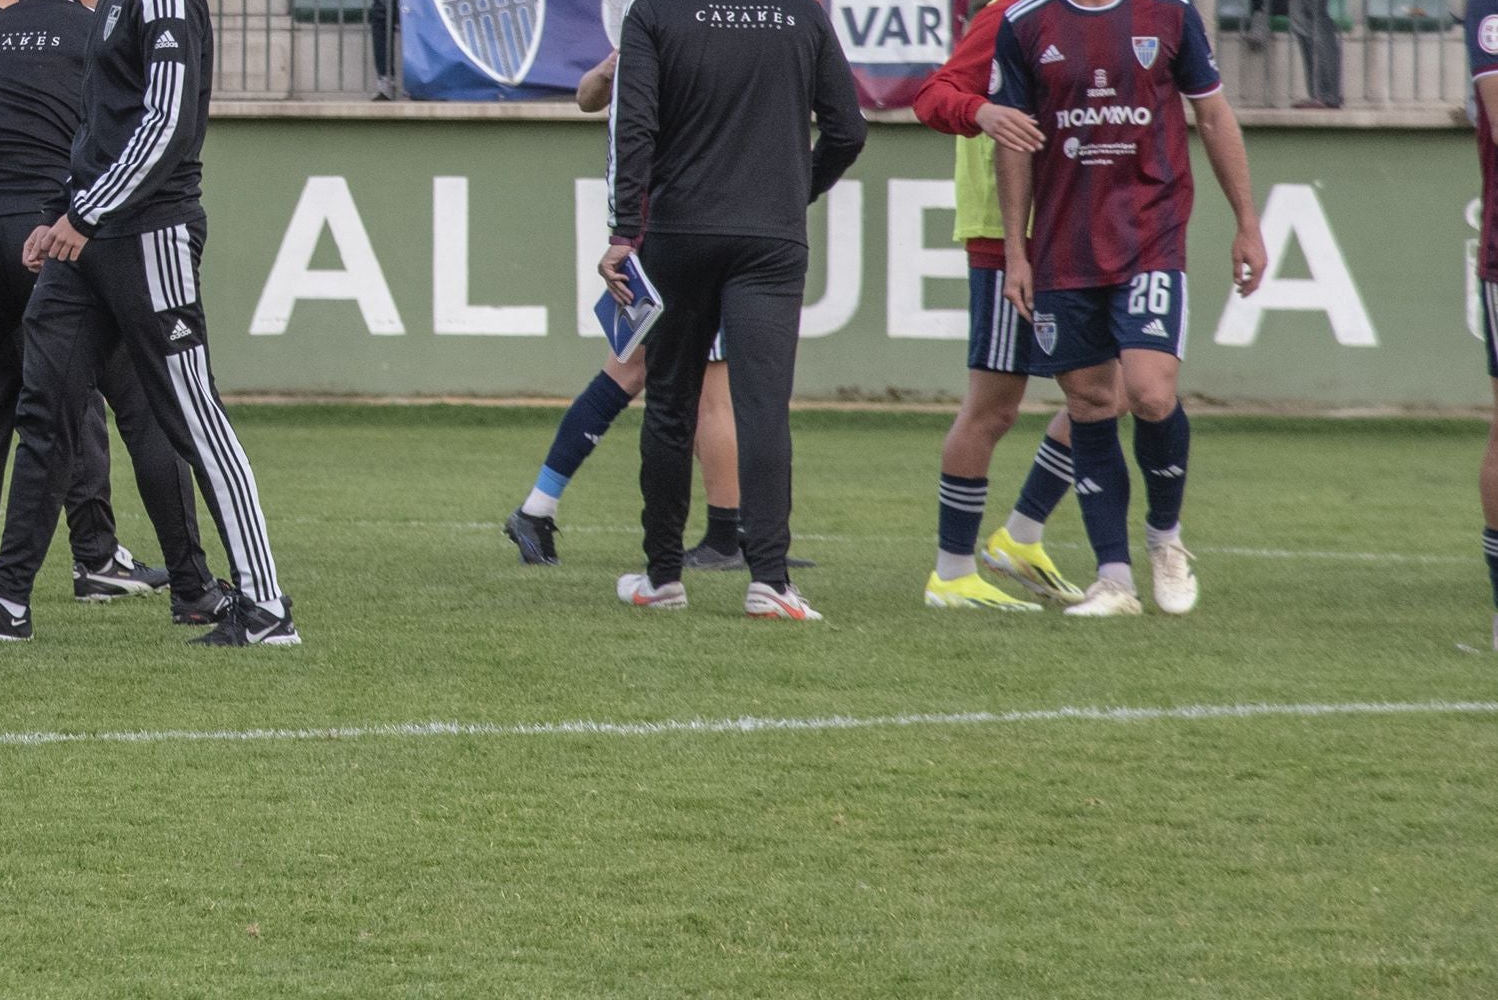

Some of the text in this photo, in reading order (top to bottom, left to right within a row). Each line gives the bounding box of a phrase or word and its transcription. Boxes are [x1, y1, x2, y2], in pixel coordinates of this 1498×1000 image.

[154, 40, 179, 50] adidas
[841, 5, 944, 48] VAR
[1127, 270, 1172, 316] 26
